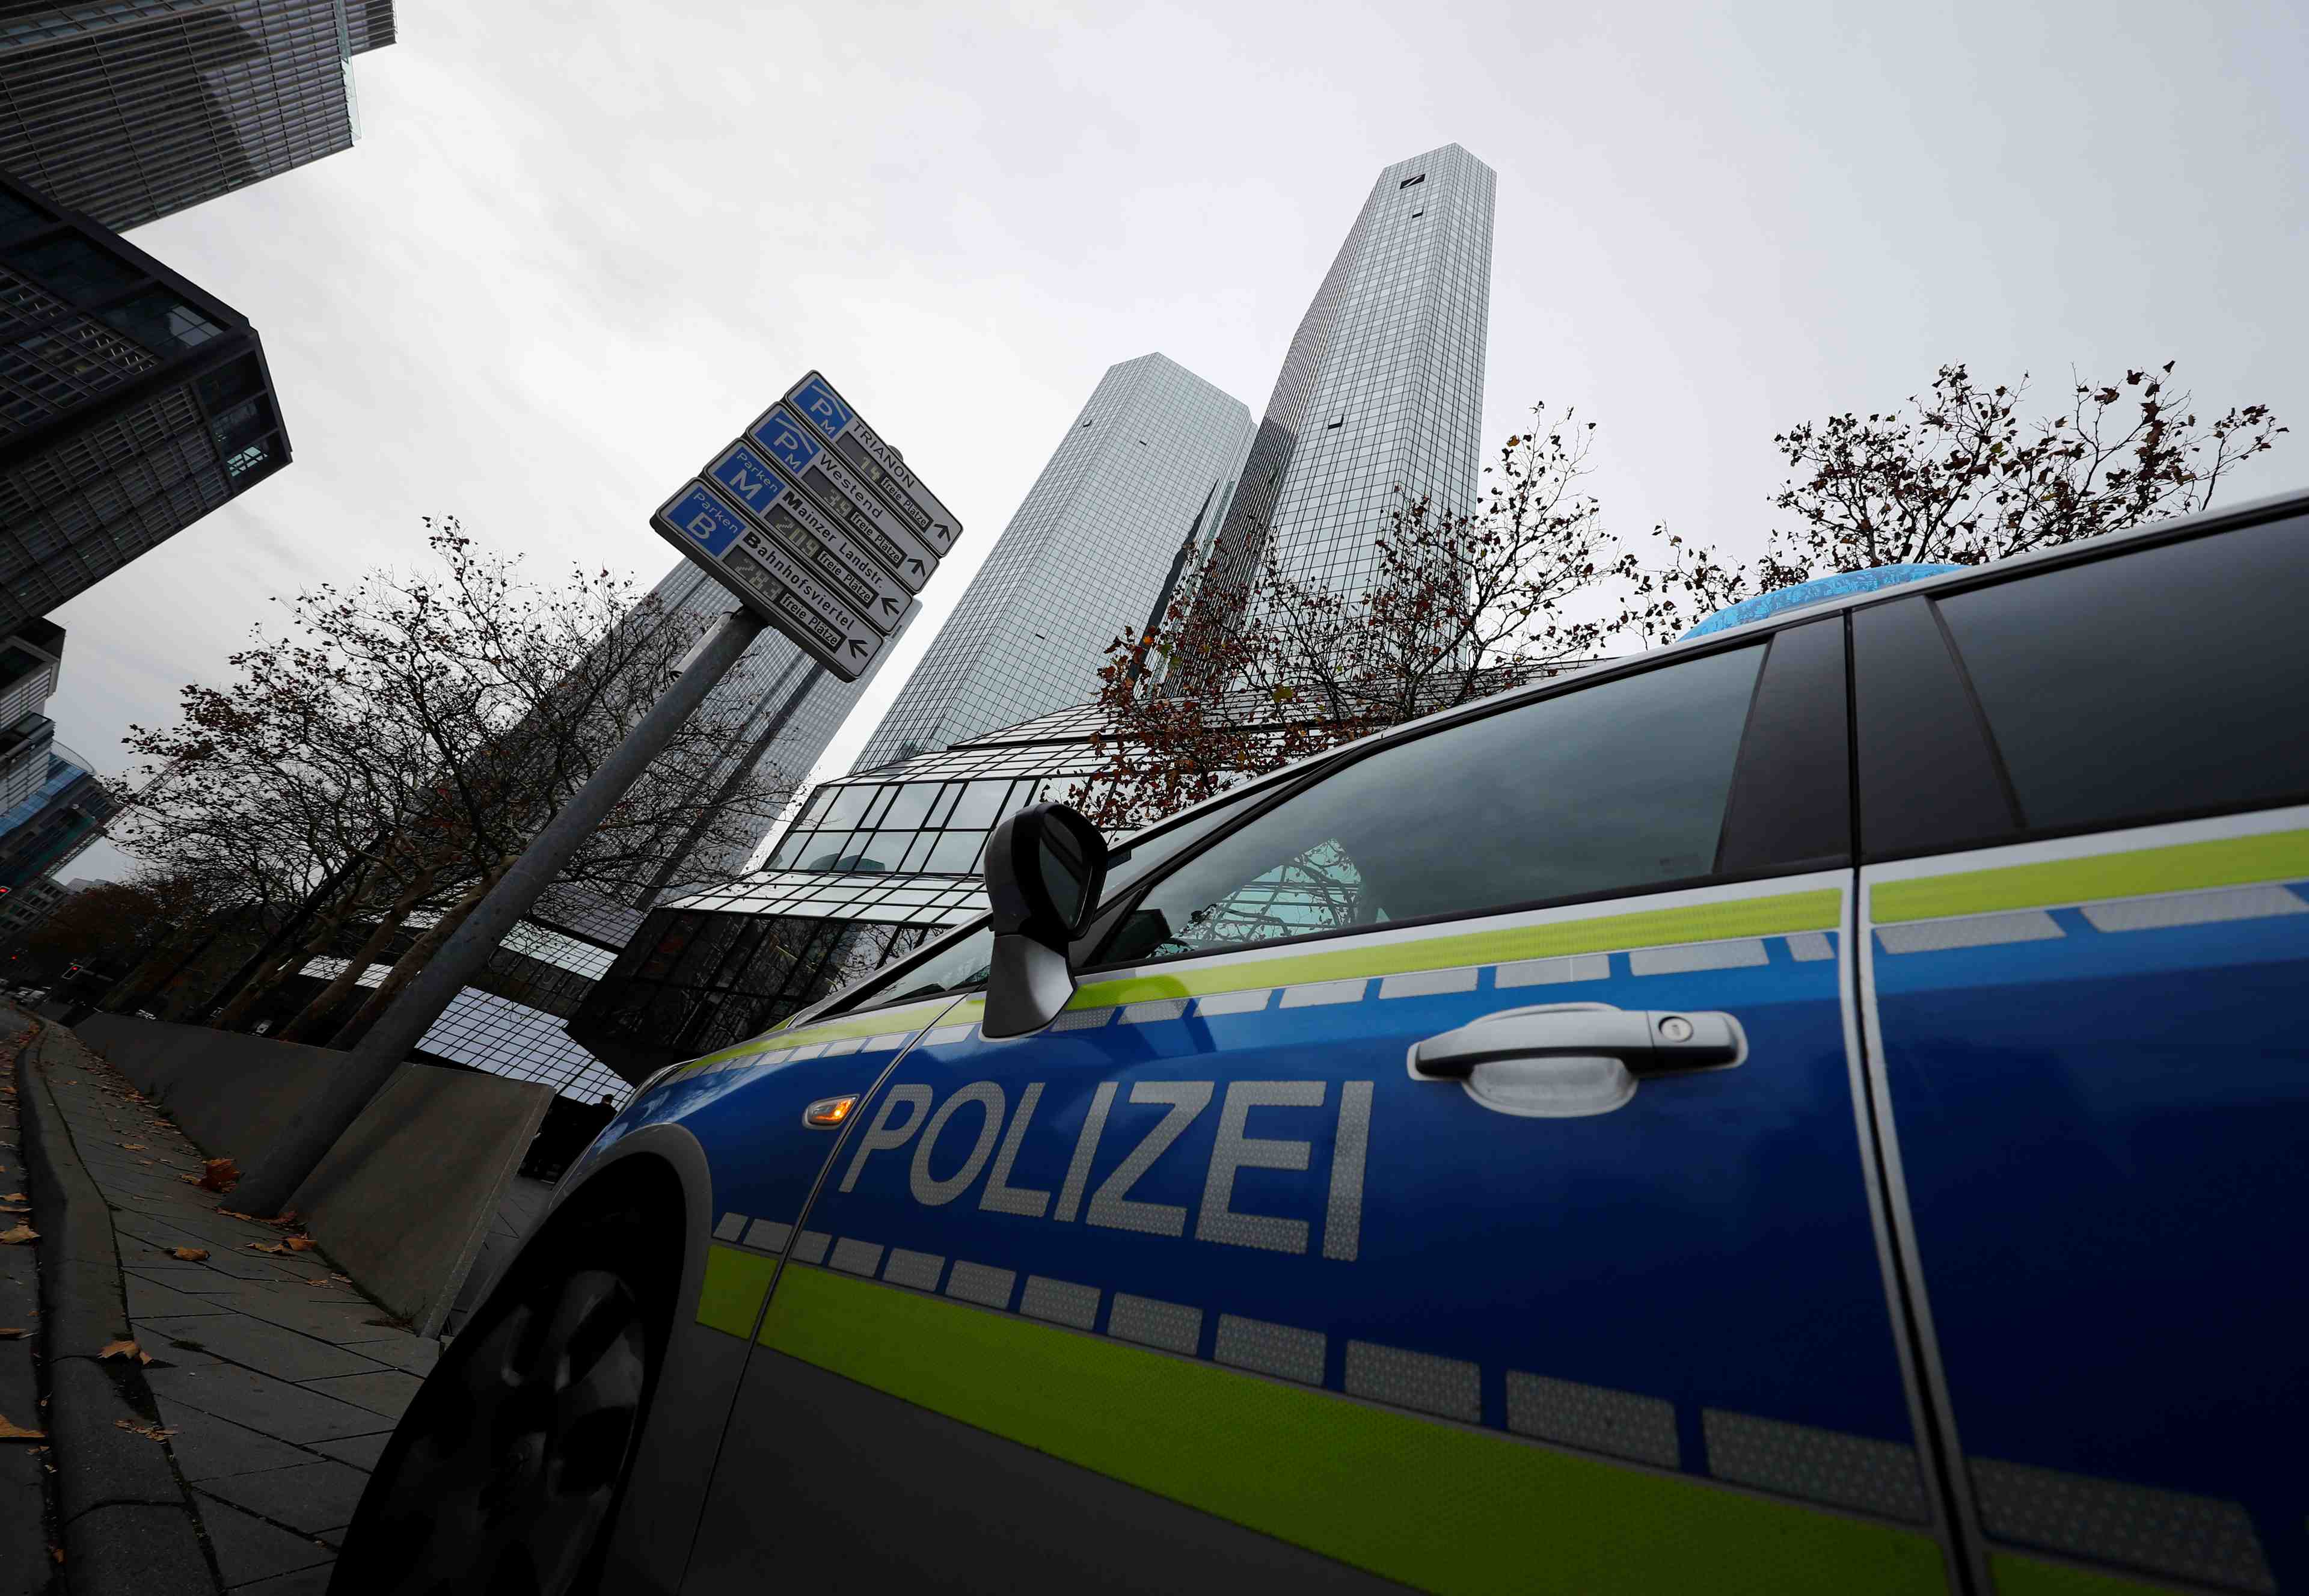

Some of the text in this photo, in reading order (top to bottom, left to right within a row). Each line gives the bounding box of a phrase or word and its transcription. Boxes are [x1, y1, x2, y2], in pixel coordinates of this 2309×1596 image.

[810, 397, 833, 416] P
[820, 419, 836, 435] M
[773, 431, 799, 450] P
[785, 452, 802, 470] M
[854, 420, 915, 488] TRIANON
[728, 469, 763, 500] M
[737, 452, 778, 493] Parken
[820, 454, 883, 518] Westend
[686, 512, 717, 539] B
[693, 493, 738, 533] Parken
[882, 478, 902, 501] freie
[903, 500, 927, 526] Plätze
[782, 490, 883, 589] Mainzer Landstr.
[852, 512, 872, 536] freie
[874, 535, 900, 562] Plätze
[743, 531, 854, 631] Bahnhofsviertel
[818, 551, 842, 575] freie
[844, 573, 872, 601] Plätze
[782, 595, 806, 619] freie
[808, 616, 838, 645] Plätze
[839, 1080, 1373, 1262] POLIZEI
